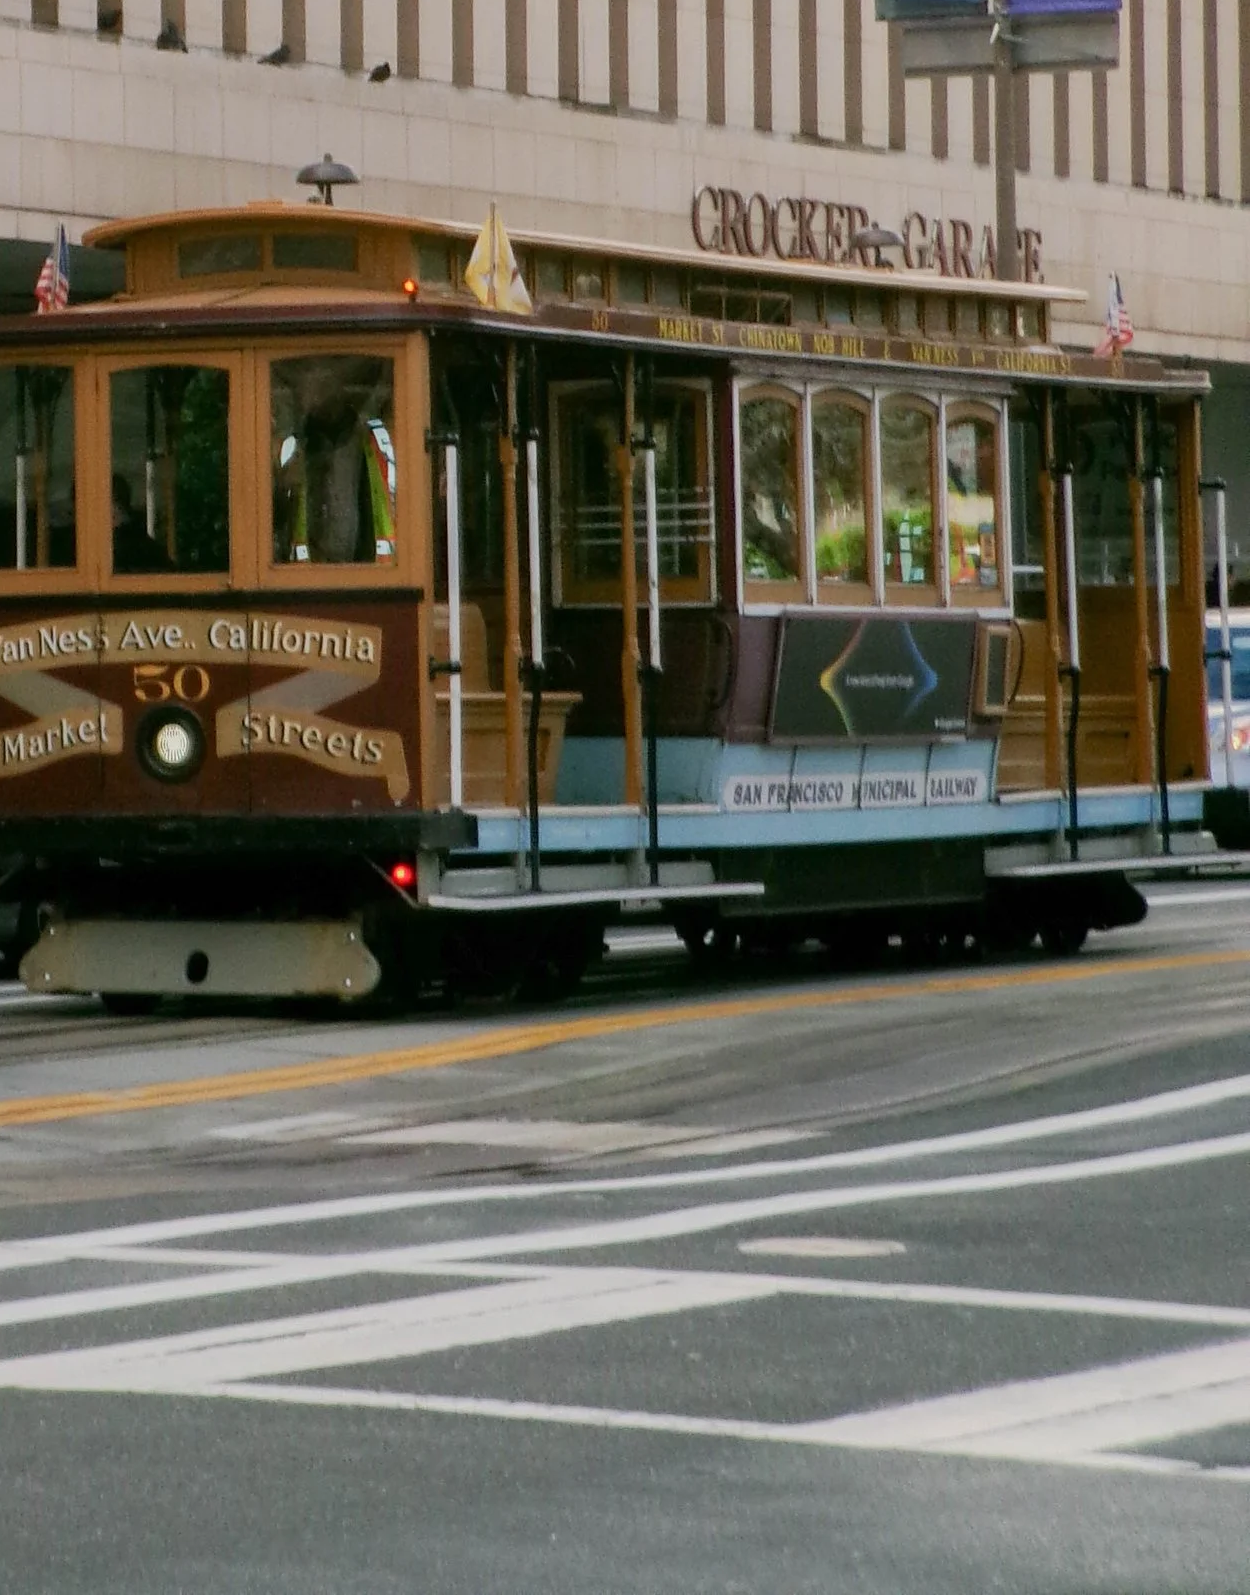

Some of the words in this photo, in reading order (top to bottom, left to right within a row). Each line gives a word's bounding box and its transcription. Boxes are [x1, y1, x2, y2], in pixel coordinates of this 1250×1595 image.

[691, 185, 874, 268] CROCKER
[903, 211, 1044, 284] GARAE
[659, 317, 703, 343] MARKET
[739, 327, 802, 353] CHINATOWN
[813, 333, 835, 355] NOB
[40, 622, 109, 656] Ness
[209, 618, 376, 664] California
[133, 664, 210, 703] 50
[3, 714, 109, 765] Market
[241, 712, 384, 766] Streets
[733, 782, 762, 805] SAN
[767, 780, 843, 805] FRANCISCO
